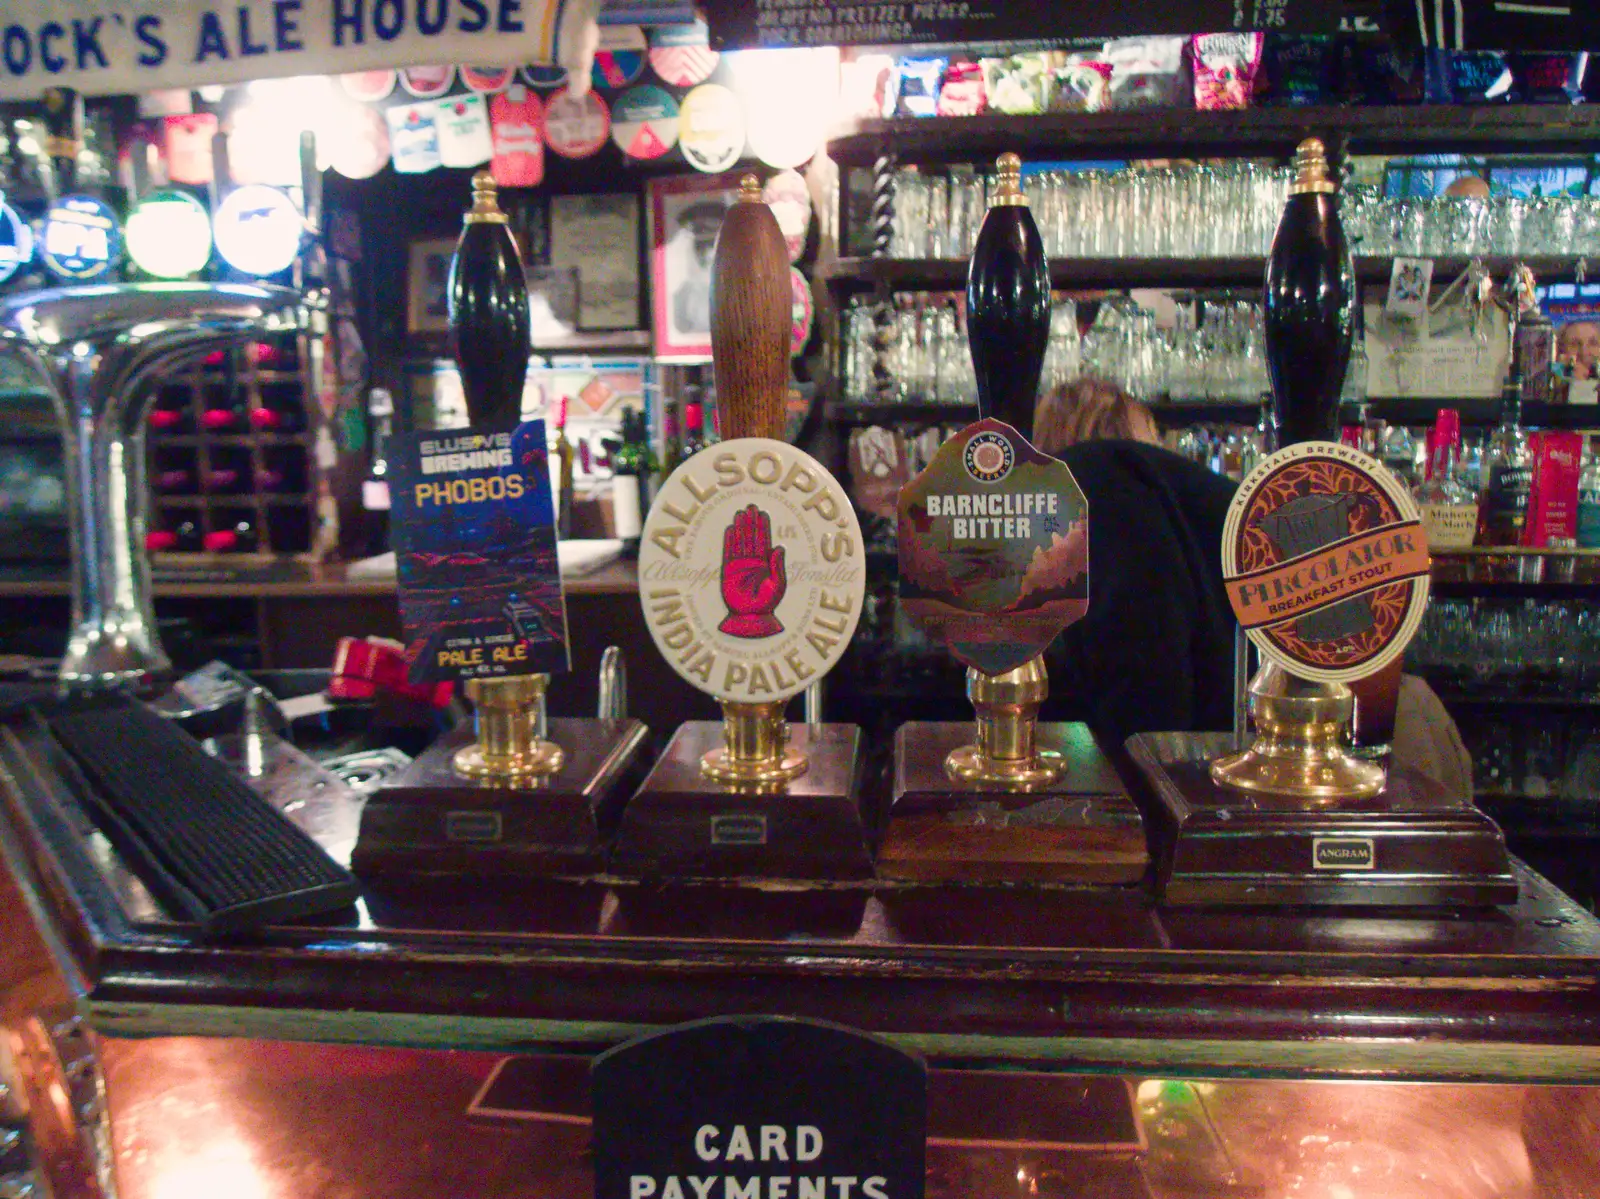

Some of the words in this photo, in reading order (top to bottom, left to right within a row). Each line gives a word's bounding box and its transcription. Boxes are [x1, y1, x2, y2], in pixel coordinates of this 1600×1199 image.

[194, 0, 304, 63] ALE
[332, 0, 524, 47] HOUSE
[414, 474, 525, 508] PHOBOS
[1237, 450, 1298, 506] KIRKSTALL
[1306, 446, 1377, 471] BREWERY
[652, 451, 855, 563] ALLSOPP'S
[927, 493, 1058, 517] BARNCLIFFE
[953, 517, 1031, 539] BITTER
[1268, 578, 1345, 614] BREAKFAST
[1349, 562, 1393, 585] STOUT
[437, 648, 484, 667] PALE
[493, 644, 528, 662] ALE
[650, 588, 716, 682] INDIA
[724, 651, 816, 694] PALE
[806, 589, 853, 660] ALE
[1320, 848, 1369, 857] ANGRAM
[695, 1124, 823, 1162] CARD
[630, 1175, 889, 1199] PAYMENTS
